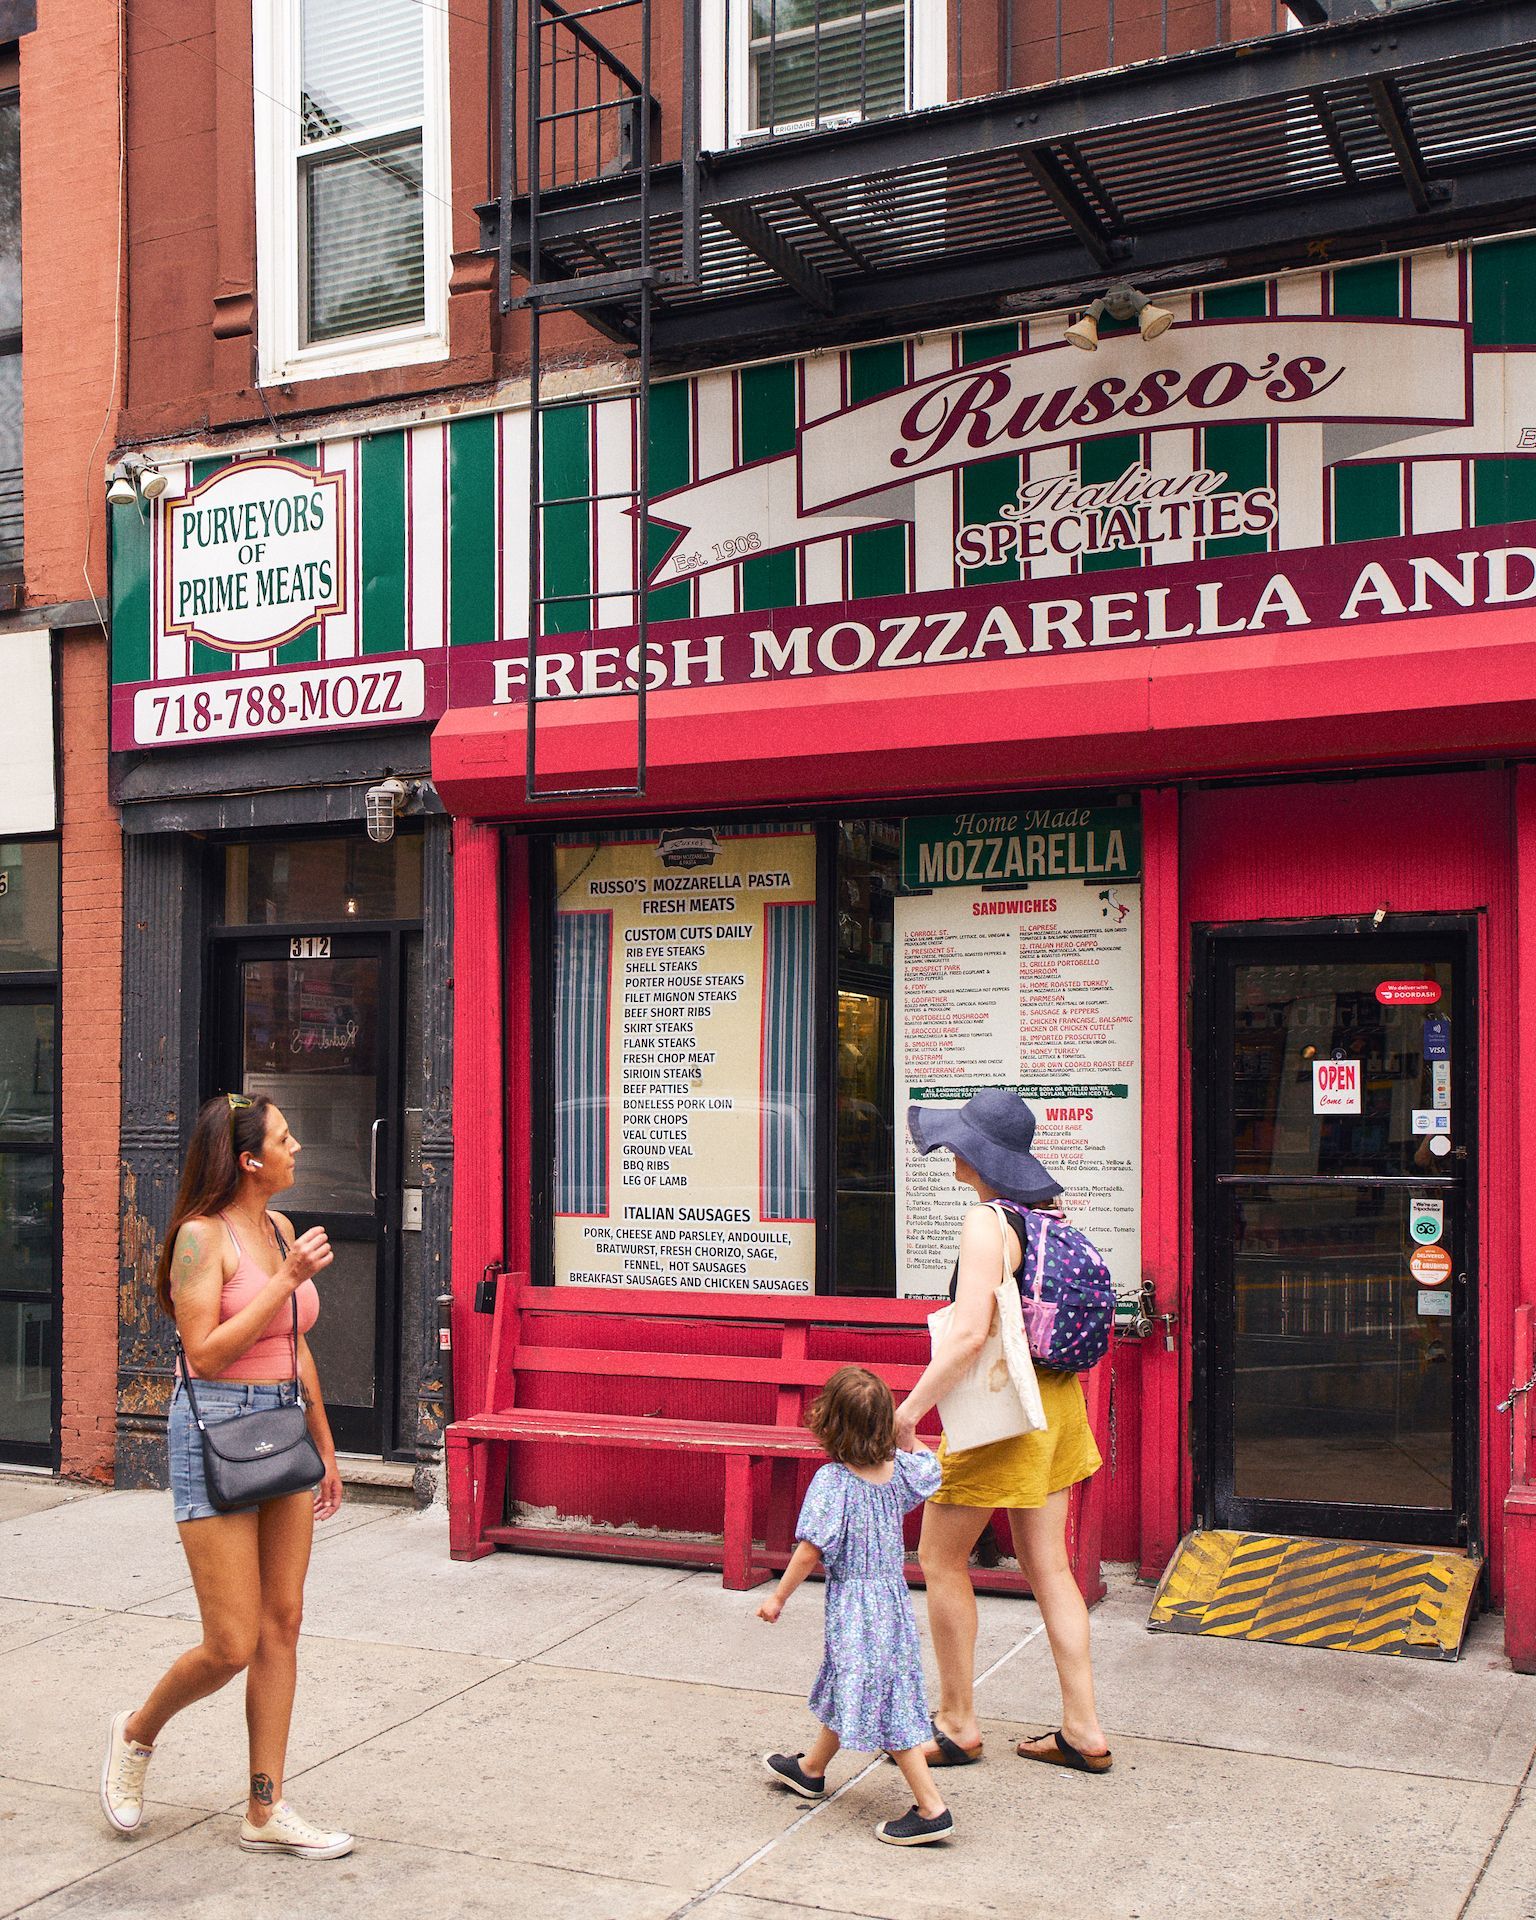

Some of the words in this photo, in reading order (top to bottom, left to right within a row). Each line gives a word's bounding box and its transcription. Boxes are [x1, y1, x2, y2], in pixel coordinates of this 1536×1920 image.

[775, 120, 815, 133] FRIGIDAIRE
[890, 353, 1346, 468] Russo's
[999, 462, 1229, 520] Italian
[182, 491, 324, 549] PURVEYORS
[956, 488, 1277, 568] SPECIALTIES
[238, 543, 266, 565] OF
[672, 549, 708, 574] Est.
[712, 531, 763, 562] 1908
[179, 572, 248, 617] PRIME
[256, 559, 332, 606] MEATS
[492, 635, 725, 704] FRESH
[749, 573, 1311, 679] MOZZARELLA
[1339, 546, 1536, 619] AND
[152, 671, 402, 737] 718-788-MOZZ
[953, 813, 1018, 836] Home
[1024, 808, 1091, 831] Made
[918, 829, 1127, 883] MOZZARELLA
[590, 879, 647, 895] RUSSO'S
[653, 875, 741, 892] MOZZARELLA
[749, 873, 790, 888] PASTA
[643, 899, 685, 914] FRESH
[690, 897, 735, 912] MEATS
[972, 898, 1057, 916] SANDWICHES
[625, 928, 676, 942] CUSTOM
[680, 926, 713, 939] CUTS
[716, 925, 753, 939] DAILY
[293, 937, 329, 957] 312
[626, 947, 643, 958] RIB
[646, 947, 664, 957] EYE
[666, 945, 705, 956] STEAKS
[625, 963, 656, 973] SHELL
[659, 961, 698, 972] STEAKS
[625, 977, 665, 988] PORTER
[667, 976, 702, 987] HOUSE
[705, 975, 745, 986] STEAKS
[625, 992, 651, 1003] FILET
[653, 991, 695, 1002] MIGNON
[698, 990, 737, 1001] STEAKS
[624, 1007, 648, 1018] BEEF
[650, 1007, 685, 1018] SHORT
[687, 1006, 711, 1017] RIBS
[623, 1023, 653, 1034] SKIRT
[655, 1022, 693, 1032] STEAKS
[623, 1038, 655, 1049] FLANK
[658, 1037, 696, 1048] STEAKS
[623, 1053, 654, 1064] FRESH
[657, 1053, 685, 1063] CHOP
[688, 1052, 715, 1063] MEAT
[663, 1068, 702, 1078] STEAKS
[1318, 1066, 1355, 1090] OPEN
[623, 1084, 647, 1094] BEEF
[649, 1083, 689, 1094] PATTIES
[623, 1099, 674, 1109] BONELESS
[677, 1099, 705, 1109] PORK
[708, 1099, 733, 1109] LOIN
[1320, 1095, 1342, 1106] Come
[623, 1114, 651, 1124] PORK
[653, 1114, 688, 1125] CHOPS
[1046, 1107, 1093, 1121] WRAPS
[623, 1130, 647, 1140] VEAL
[649, 1130, 687, 1140] CUTLES
[623, 1145, 666, 1155] GROUND
[668, 1145, 693, 1156] VEAL
[623, 1160, 644, 1171] BBQ
[646, 1160, 670, 1170] RIBS
[623, 1175, 641, 1185] LEG
[643, 1175, 656, 1186] OF
[659, 1176, 688, 1186] LAMB
[624, 1206, 674, 1220] ITALIAN
[678, 1207, 750, 1222] SAUSAGES
[584, 1228, 614, 1240] PORK,
[616, 1228, 653, 1240] CHEESE
[655, 1230, 676, 1240] AND
[679, 1230, 725, 1243] PARSLEY,
[727, 1232, 791, 1246] ANDOUILLE,
[596, 1243, 658, 1256] BRATWURST,
[660, 1245, 692, 1256] FRESH
[694, 1246, 744, 1260] CHORIZO,
[747, 1248, 777, 1261] SAGE,
[624, 1259, 664, 1272] FENNEL,
[669, 1261, 690, 1271] HOT
[692, 1261, 746, 1273] SAUSAGES
[569, 1272, 624, 1284] BREAKFAST
[626, 1274, 677, 1287] SAUSAGES
[680, 1276, 701, 1287] AND
[704, 1277, 750, 1289] CHICKEN
[752, 1279, 809, 1291] SAUSAGES
